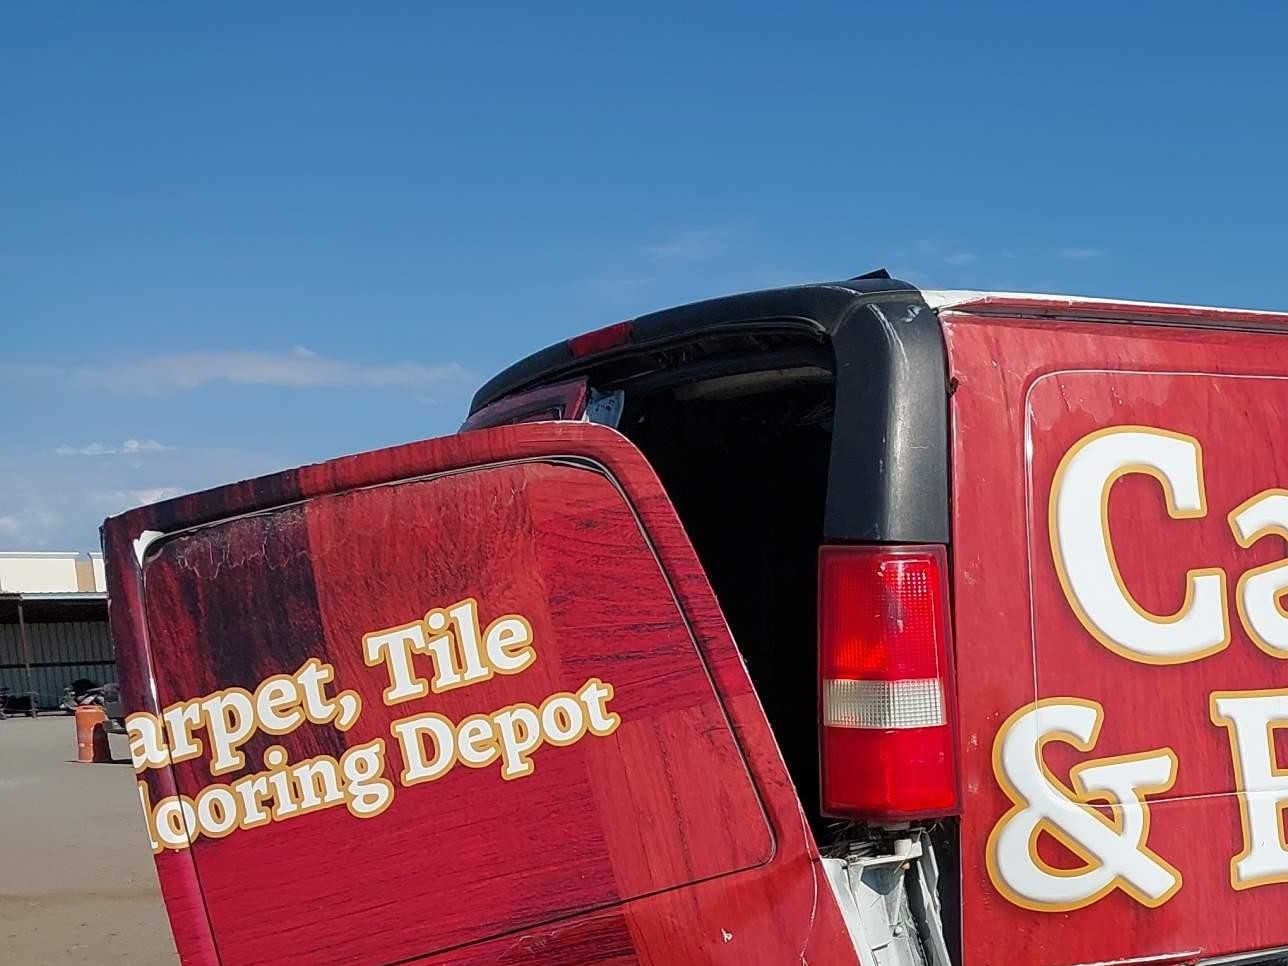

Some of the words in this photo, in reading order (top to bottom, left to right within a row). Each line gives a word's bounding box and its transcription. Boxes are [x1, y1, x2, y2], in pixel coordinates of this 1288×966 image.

[126, 660, 360, 774] arpet,
[364, 599, 536, 704] Tile
[392, 679, 619, 786] Depot
[986, 698, 1181, 910] &
